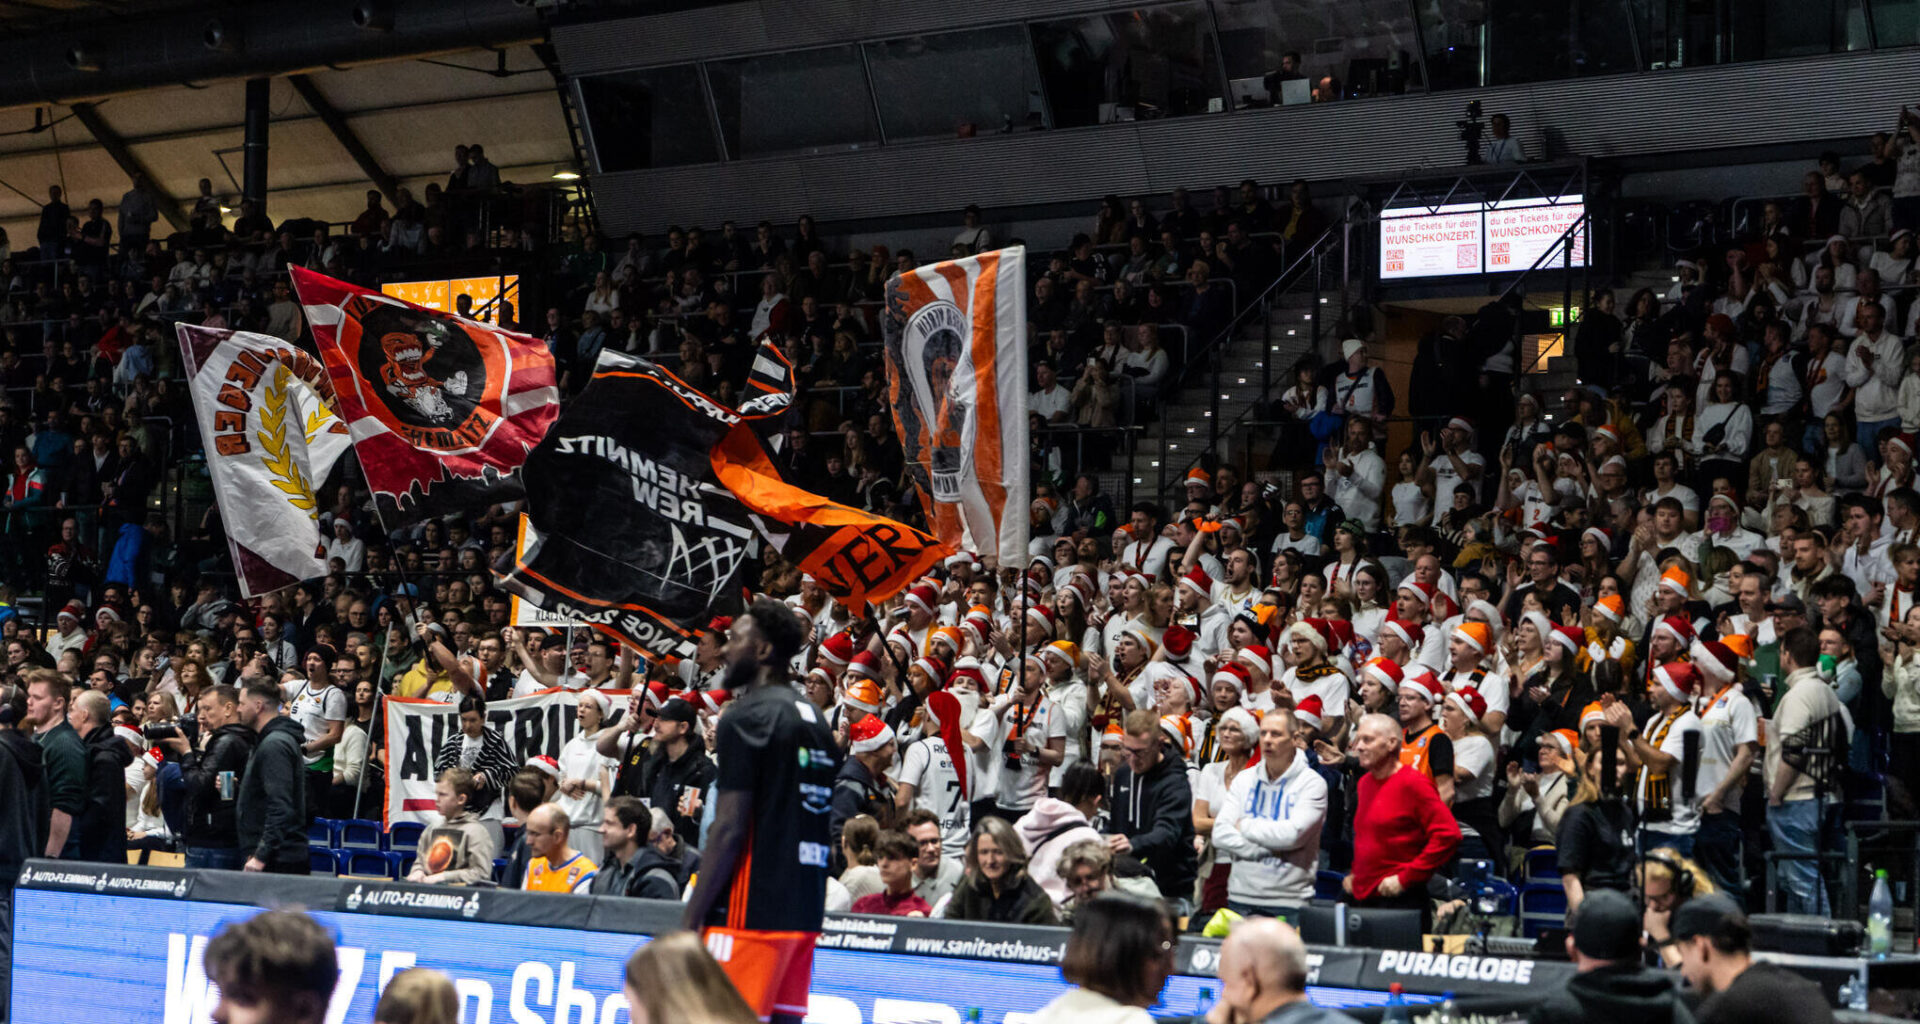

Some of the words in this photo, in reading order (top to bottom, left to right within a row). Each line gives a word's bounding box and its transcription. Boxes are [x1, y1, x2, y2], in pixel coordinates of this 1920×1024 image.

[1386, 224, 1396, 232] du
[1399, 224, 1410, 232] die
[1414, 222, 1442, 231] Tickets
[1460, 219, 1477, 228] dein
[1520, 214, 1549, 223] Tickets
[1386, 230, 1478, 245] WUNSCHKONZERT.
[946, 780, 962, 812] 7
[32, 870, 96, 886] AUTO-FLEMMING
[108, 876, 175, 892] AUTO-FLEMMING
[364, 890, 464, 910] AUTO-FLEMMING
[1378, 950, 1536, 985] PURAGLOBE
